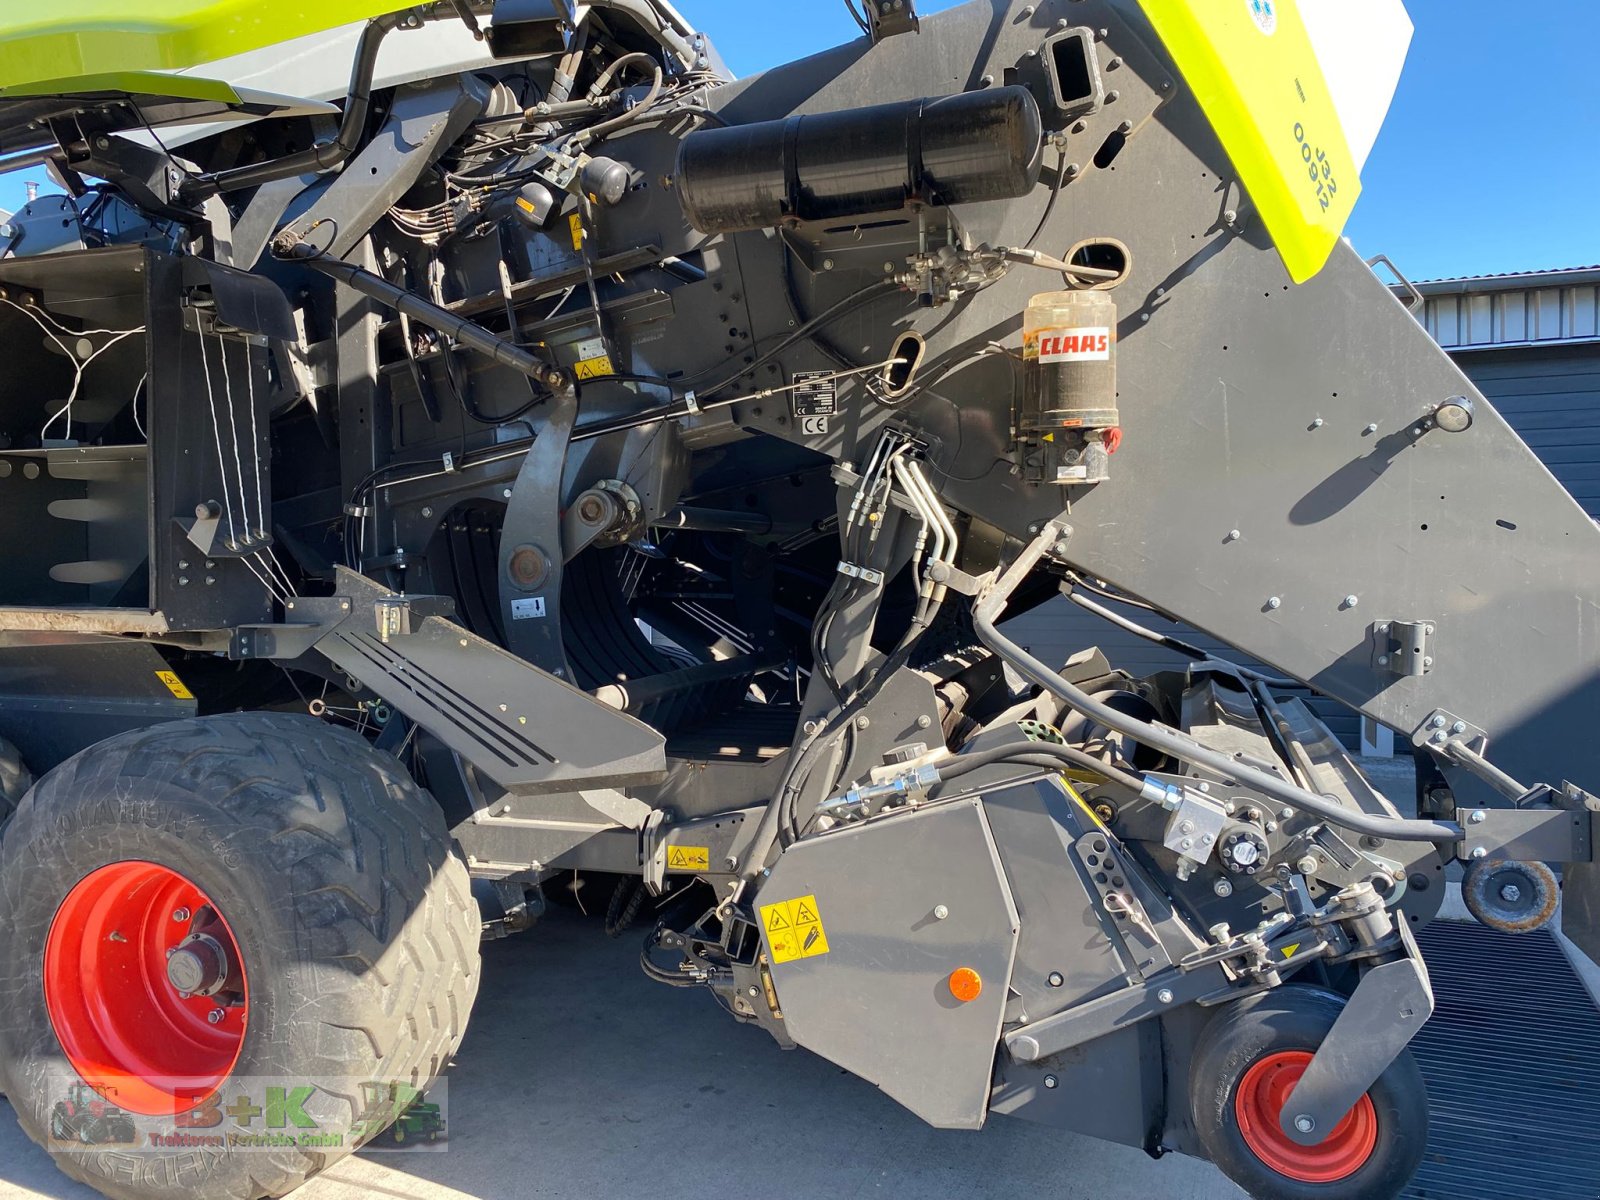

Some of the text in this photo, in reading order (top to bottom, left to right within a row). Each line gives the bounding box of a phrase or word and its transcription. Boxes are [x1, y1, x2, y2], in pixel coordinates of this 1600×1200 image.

[1294, 122, 1329, 213] 00912
[1315, 147, 1336, 198] J32
[1040, 335, 1107, 356] CLAAS
[805, 417, 825, 433] CE
